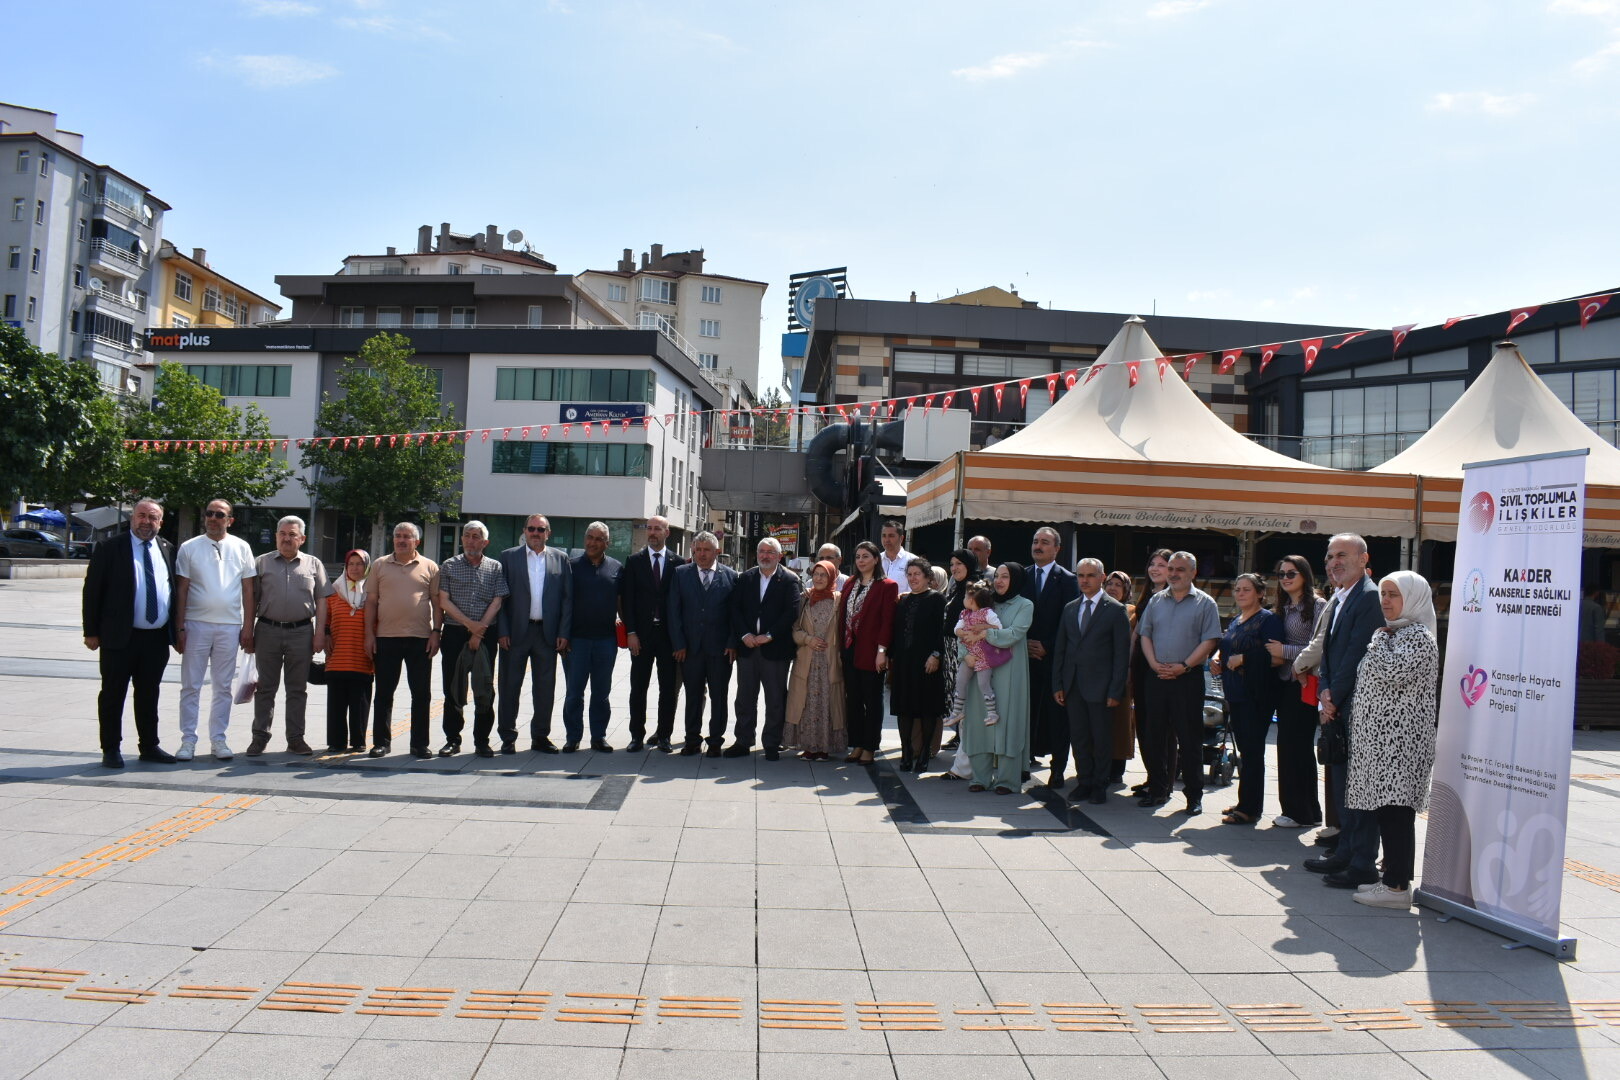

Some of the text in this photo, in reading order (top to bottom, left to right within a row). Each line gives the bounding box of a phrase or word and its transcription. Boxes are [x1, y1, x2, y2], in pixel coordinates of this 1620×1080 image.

[150, 332, 211, 349] matplus
[1525, 490, 1577, 505] TOPLUMLA
[1135, 511, 1196, 524] Belediyesi
[1200, 513, 1241, 527] Sosyal
[1243, 515, 1292, 529] Tesisleri
[1499, 506, 1577, 522] İLİŞKİLER
[1489, 586, 1571, 601] KANSERLE SAĞLIKLI
[1496, 603, 1562, 617] YAŞAM DERNEĞİ
[1491, 669, 1561, 688] Kanserle Hayata
[1491, 684, 1545, 702] Tutunan Eller
[1489, 699, 1517, 714] Projesi
